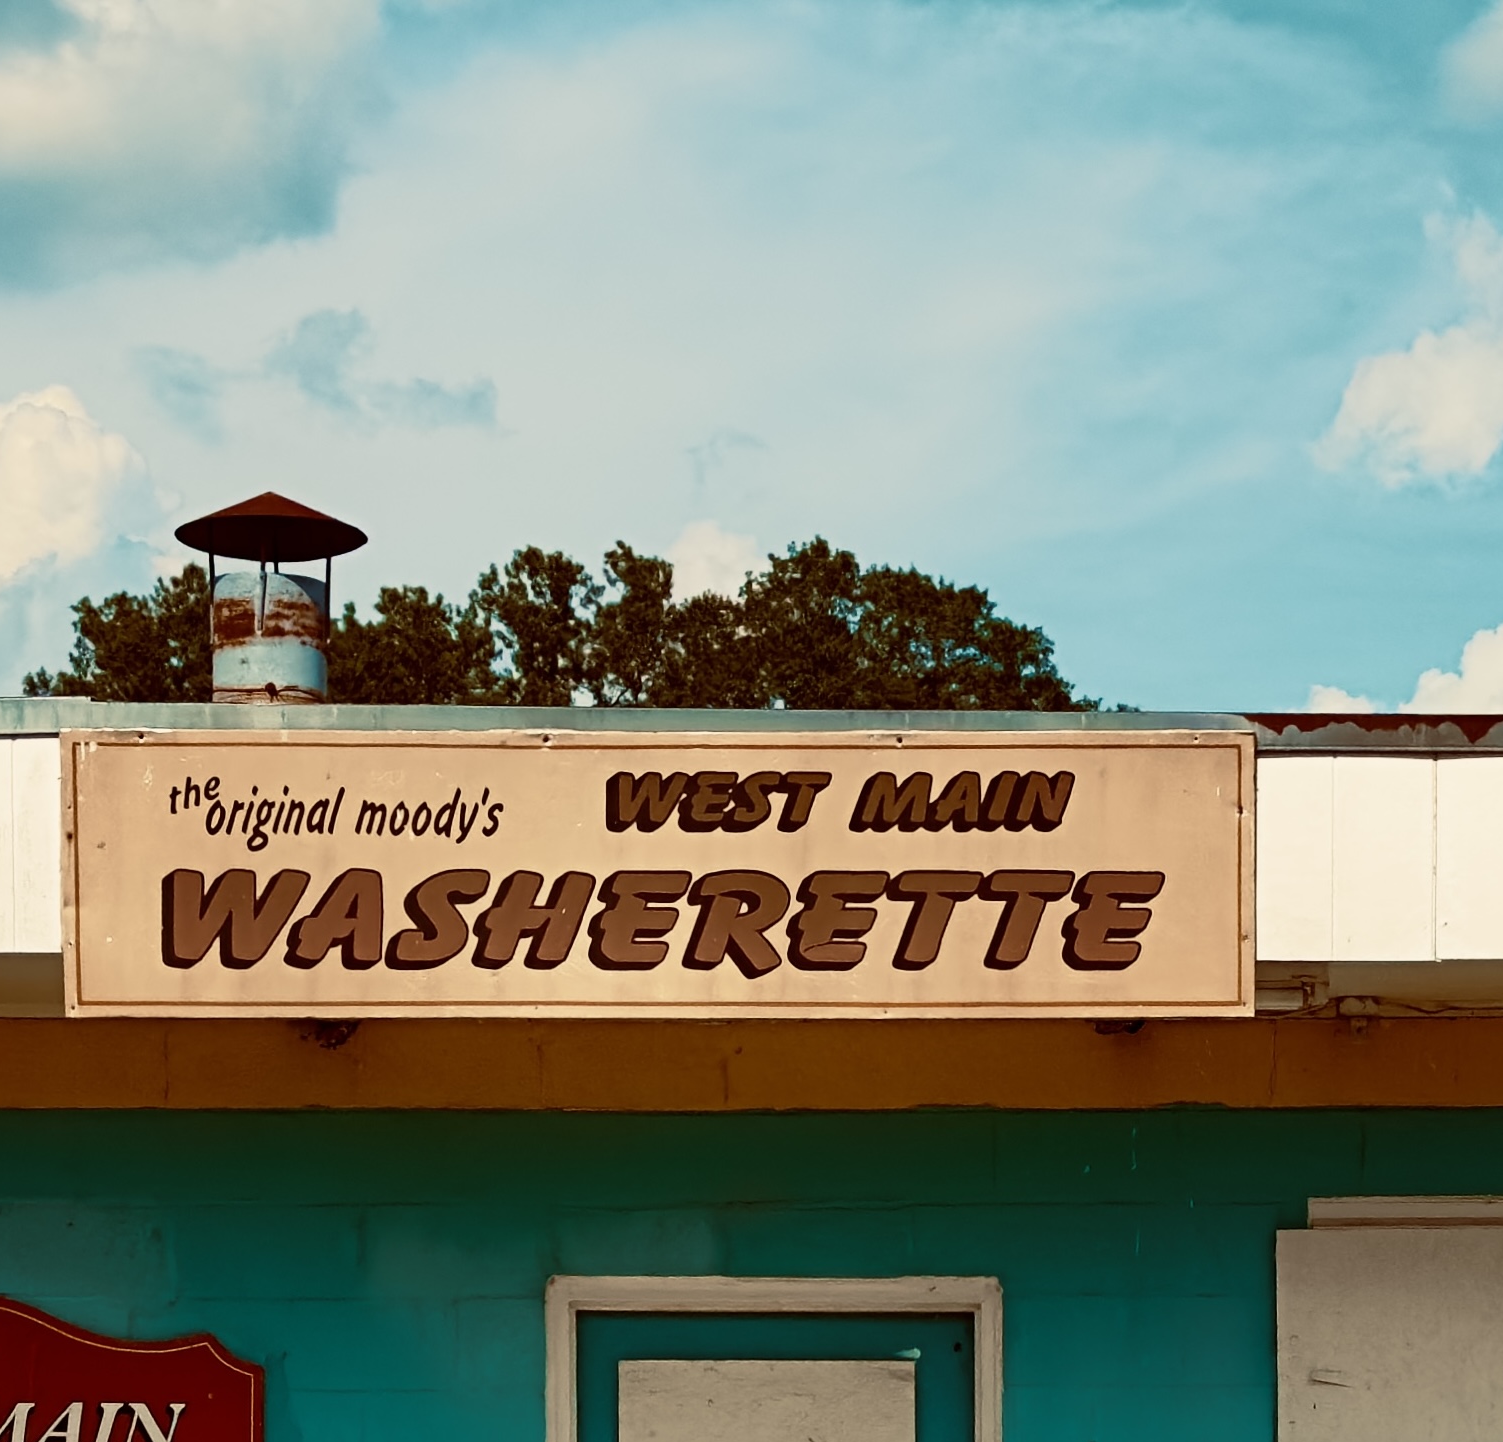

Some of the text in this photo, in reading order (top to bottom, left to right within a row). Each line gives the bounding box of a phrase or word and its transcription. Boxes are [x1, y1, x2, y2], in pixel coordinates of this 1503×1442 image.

[169, 776, 504, 852] the original moody's
[606, 771, 1076, 833] WEST MAIN
[161, 868, 1165, 979] WASHERETTE
